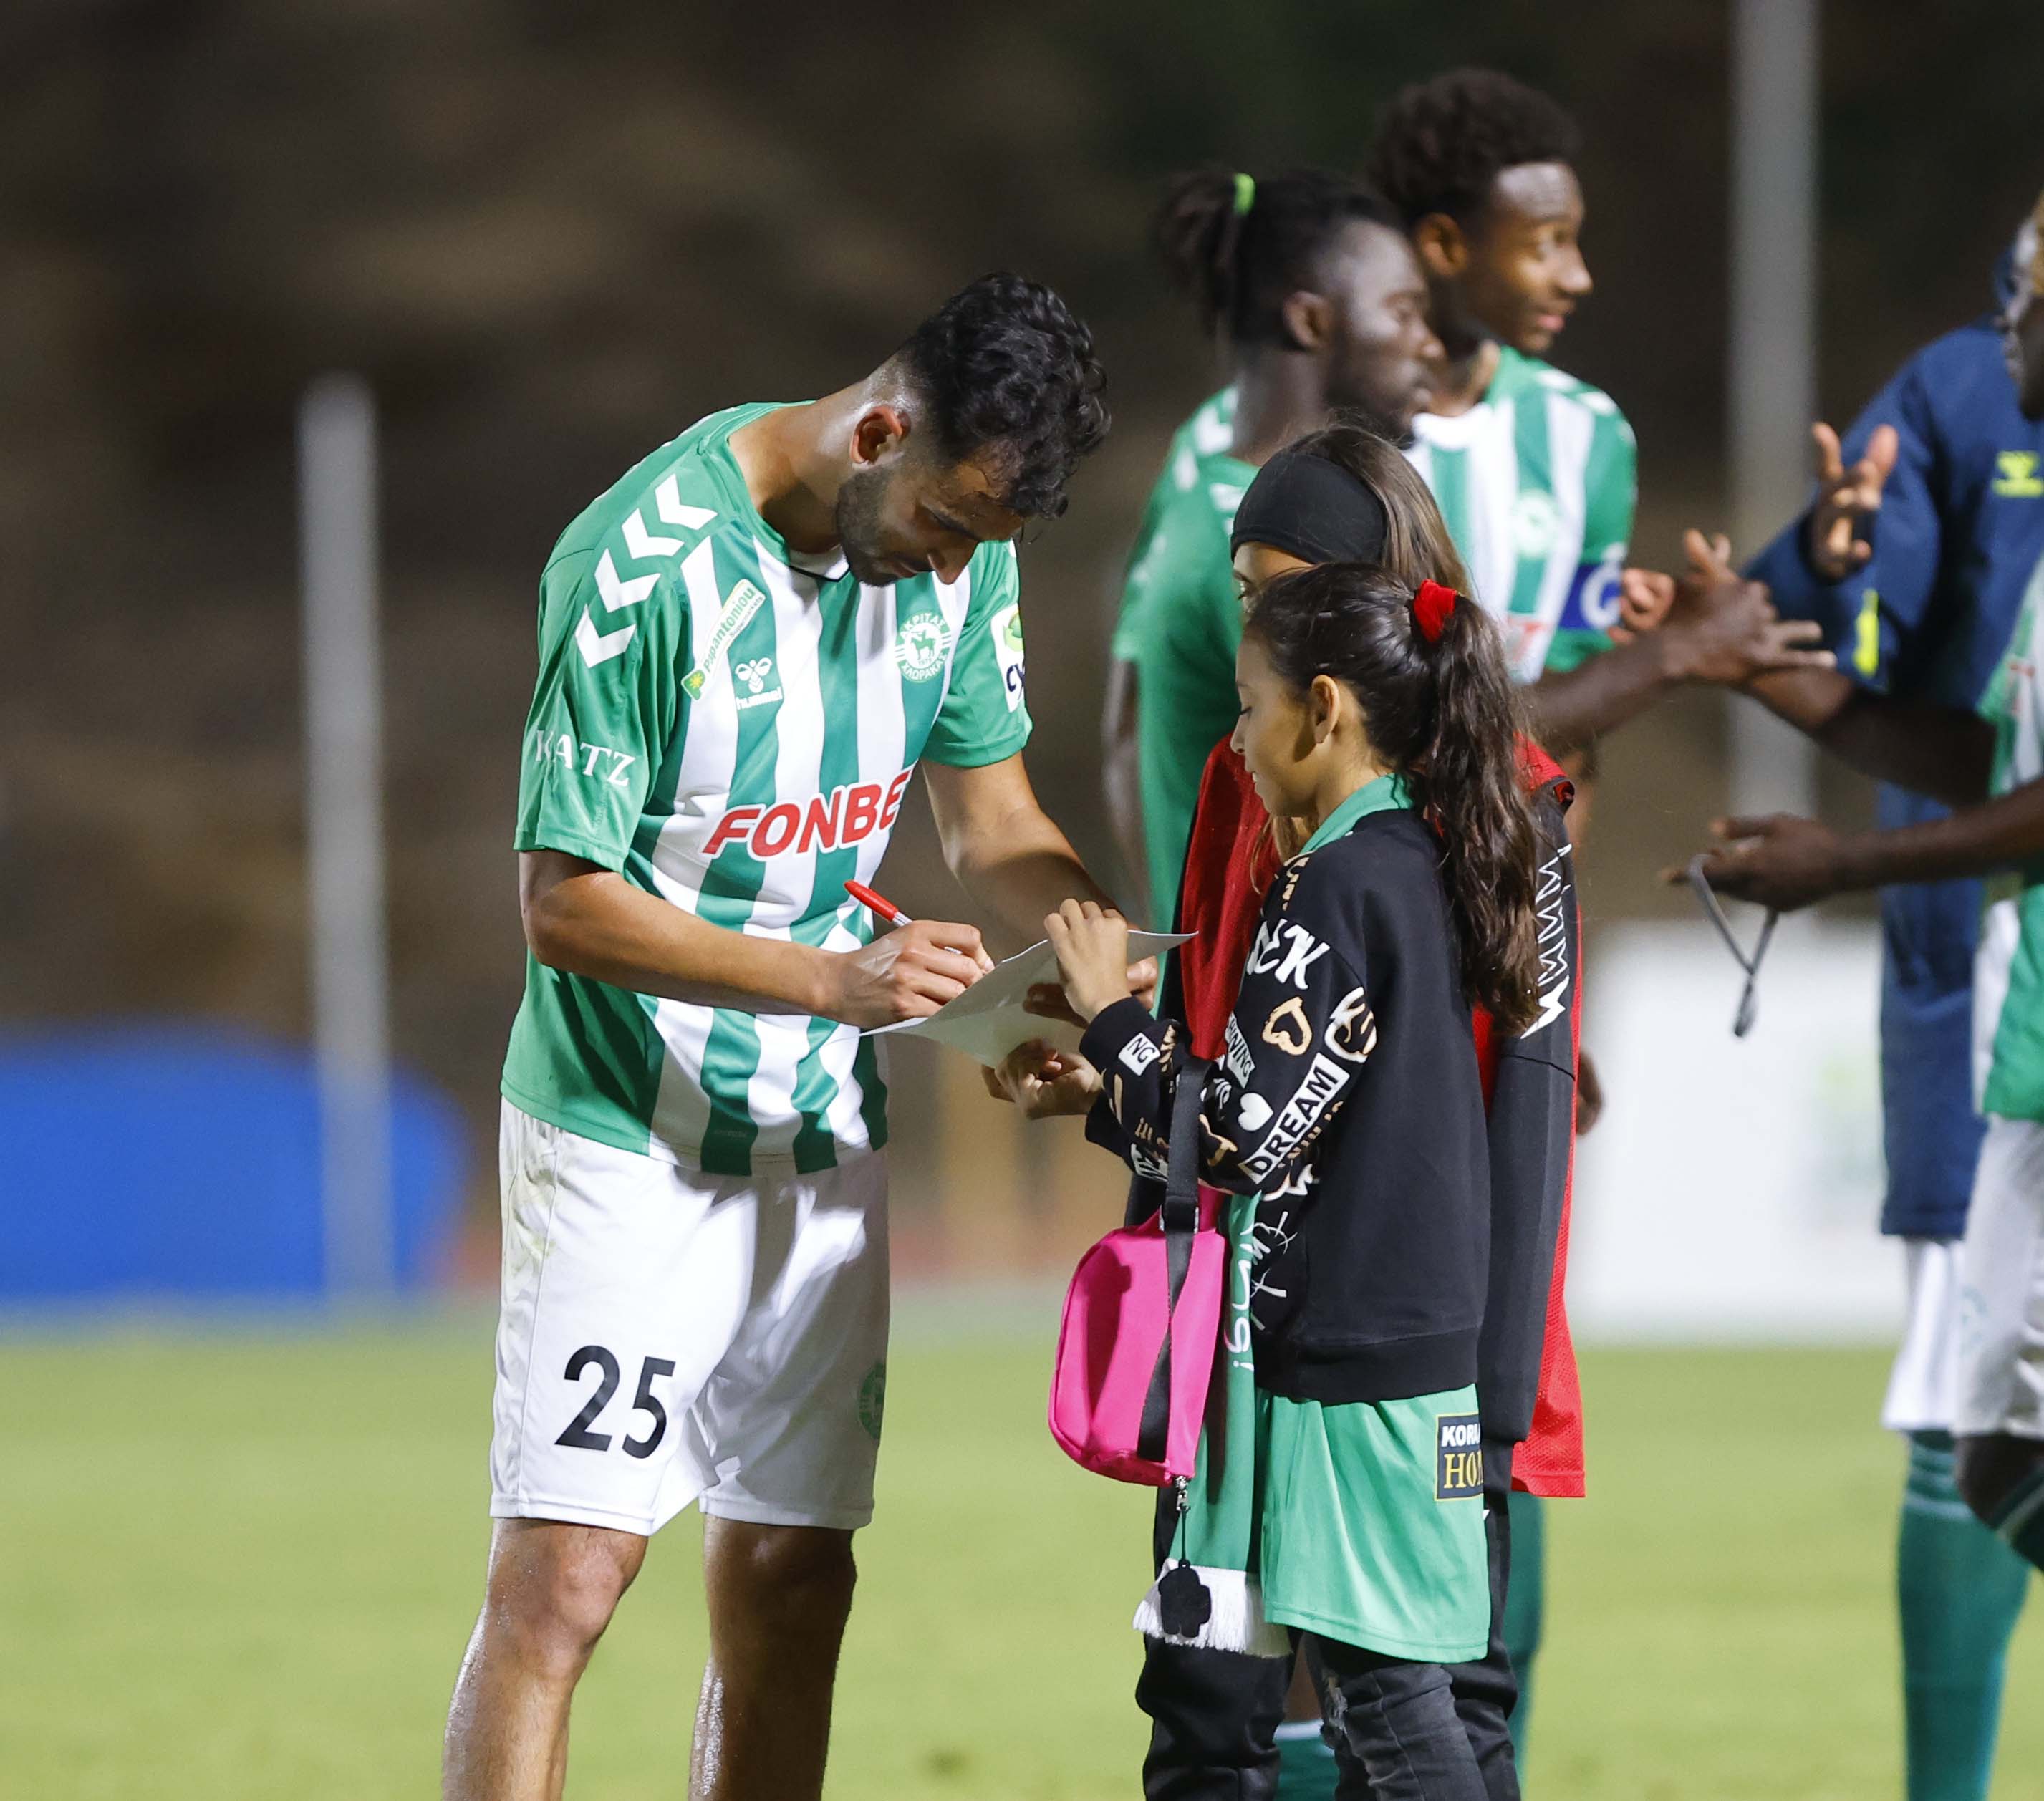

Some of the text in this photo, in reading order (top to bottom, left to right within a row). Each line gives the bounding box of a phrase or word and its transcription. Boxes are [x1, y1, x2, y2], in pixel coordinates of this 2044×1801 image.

[535, 730, 636, 787] KATZ
[1245, 1064, 1339, 1175] DREAM
[554, 1344, 677, 1459] 25
